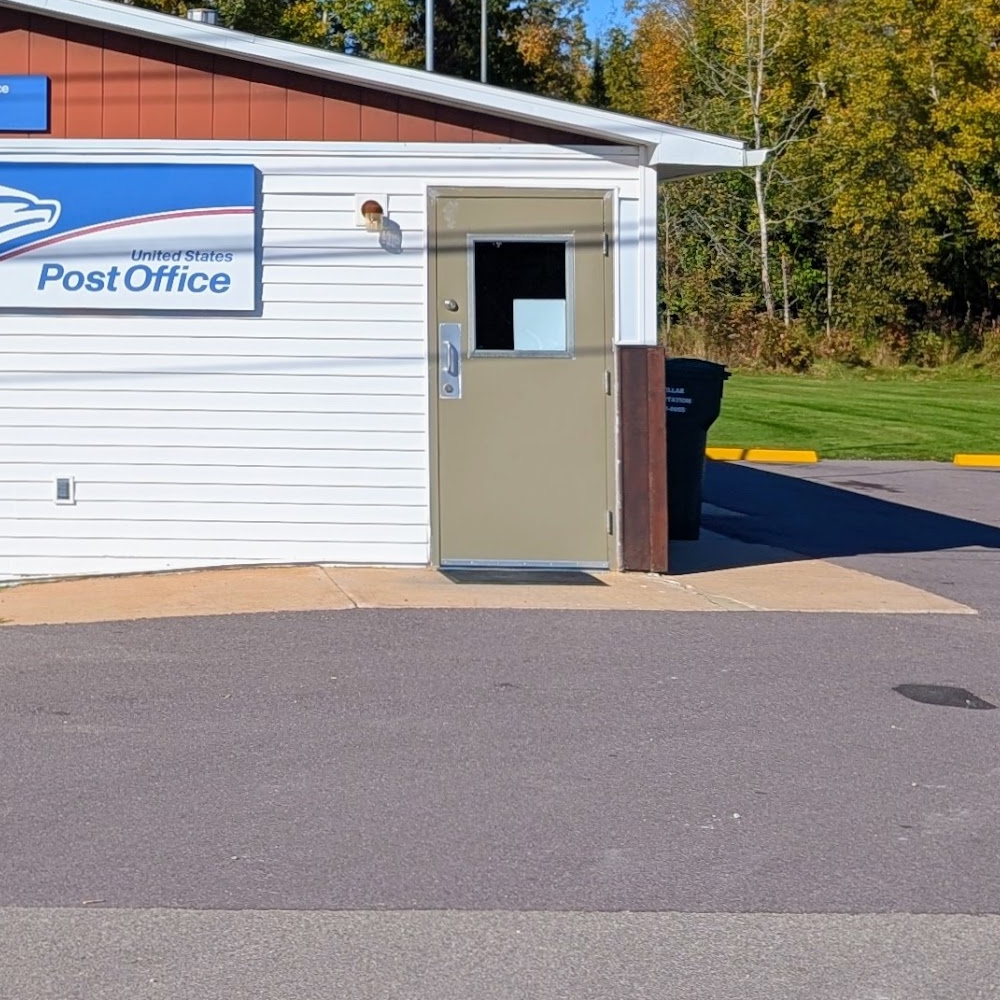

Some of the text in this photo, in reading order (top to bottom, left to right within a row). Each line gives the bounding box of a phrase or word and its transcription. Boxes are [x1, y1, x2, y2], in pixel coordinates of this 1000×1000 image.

[131, 249, 234, 262] United States
[37, 263, 232, 293] Post Office
